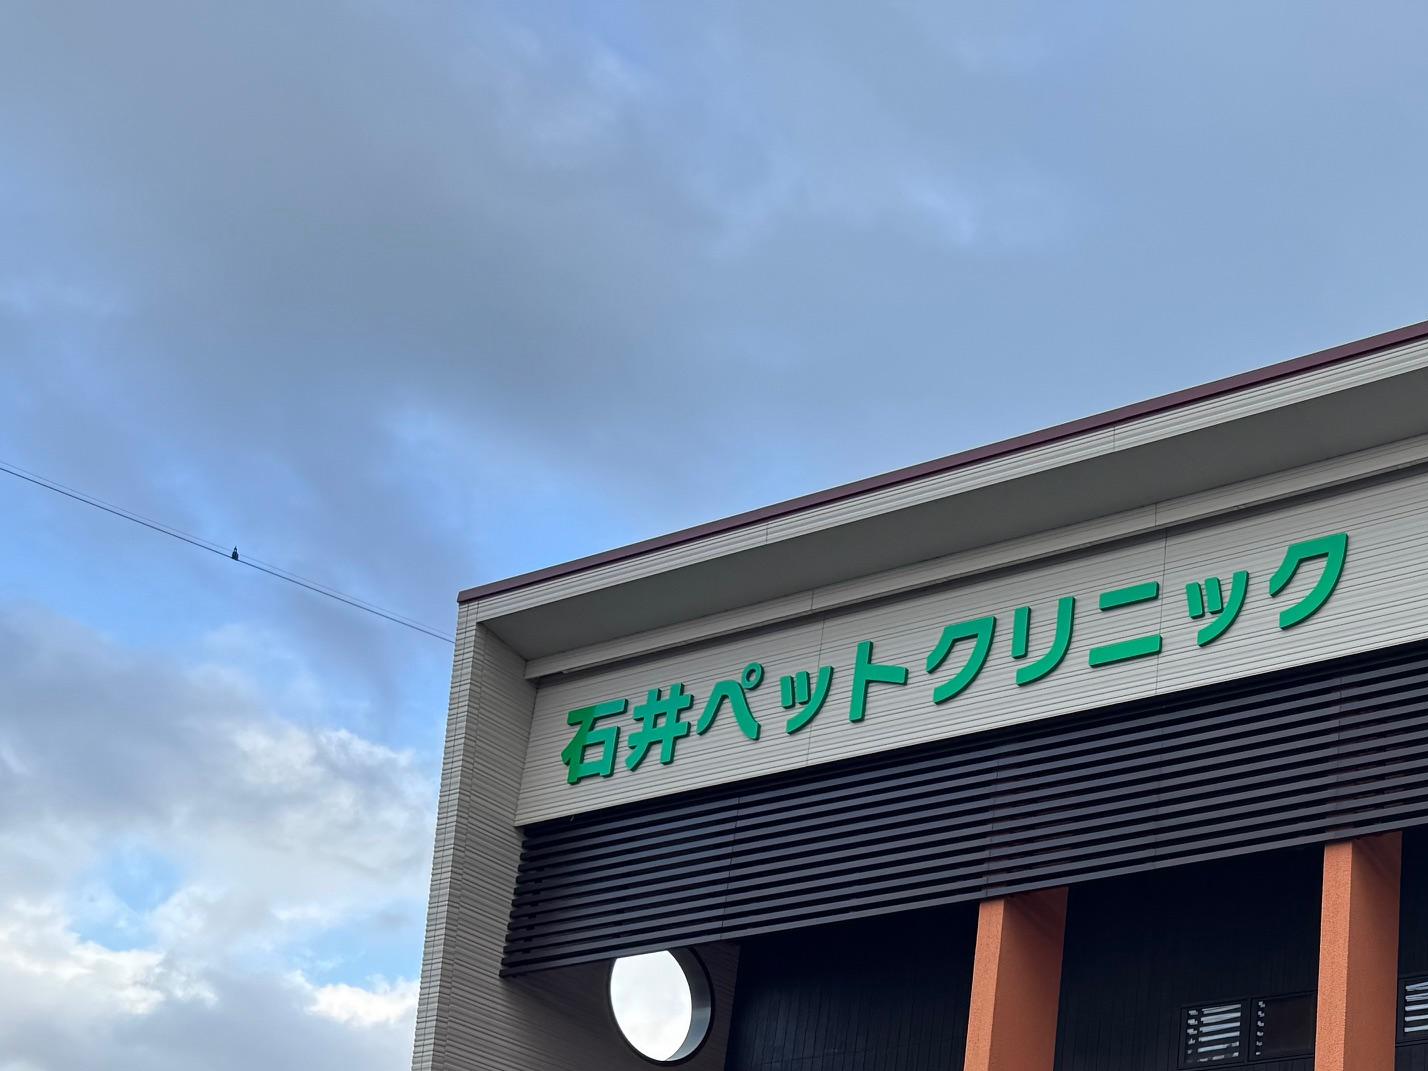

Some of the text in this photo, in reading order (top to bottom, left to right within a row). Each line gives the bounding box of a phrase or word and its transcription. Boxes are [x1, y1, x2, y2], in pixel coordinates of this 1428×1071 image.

[561, 531, 1348, 784] 石井ペットクリニック
